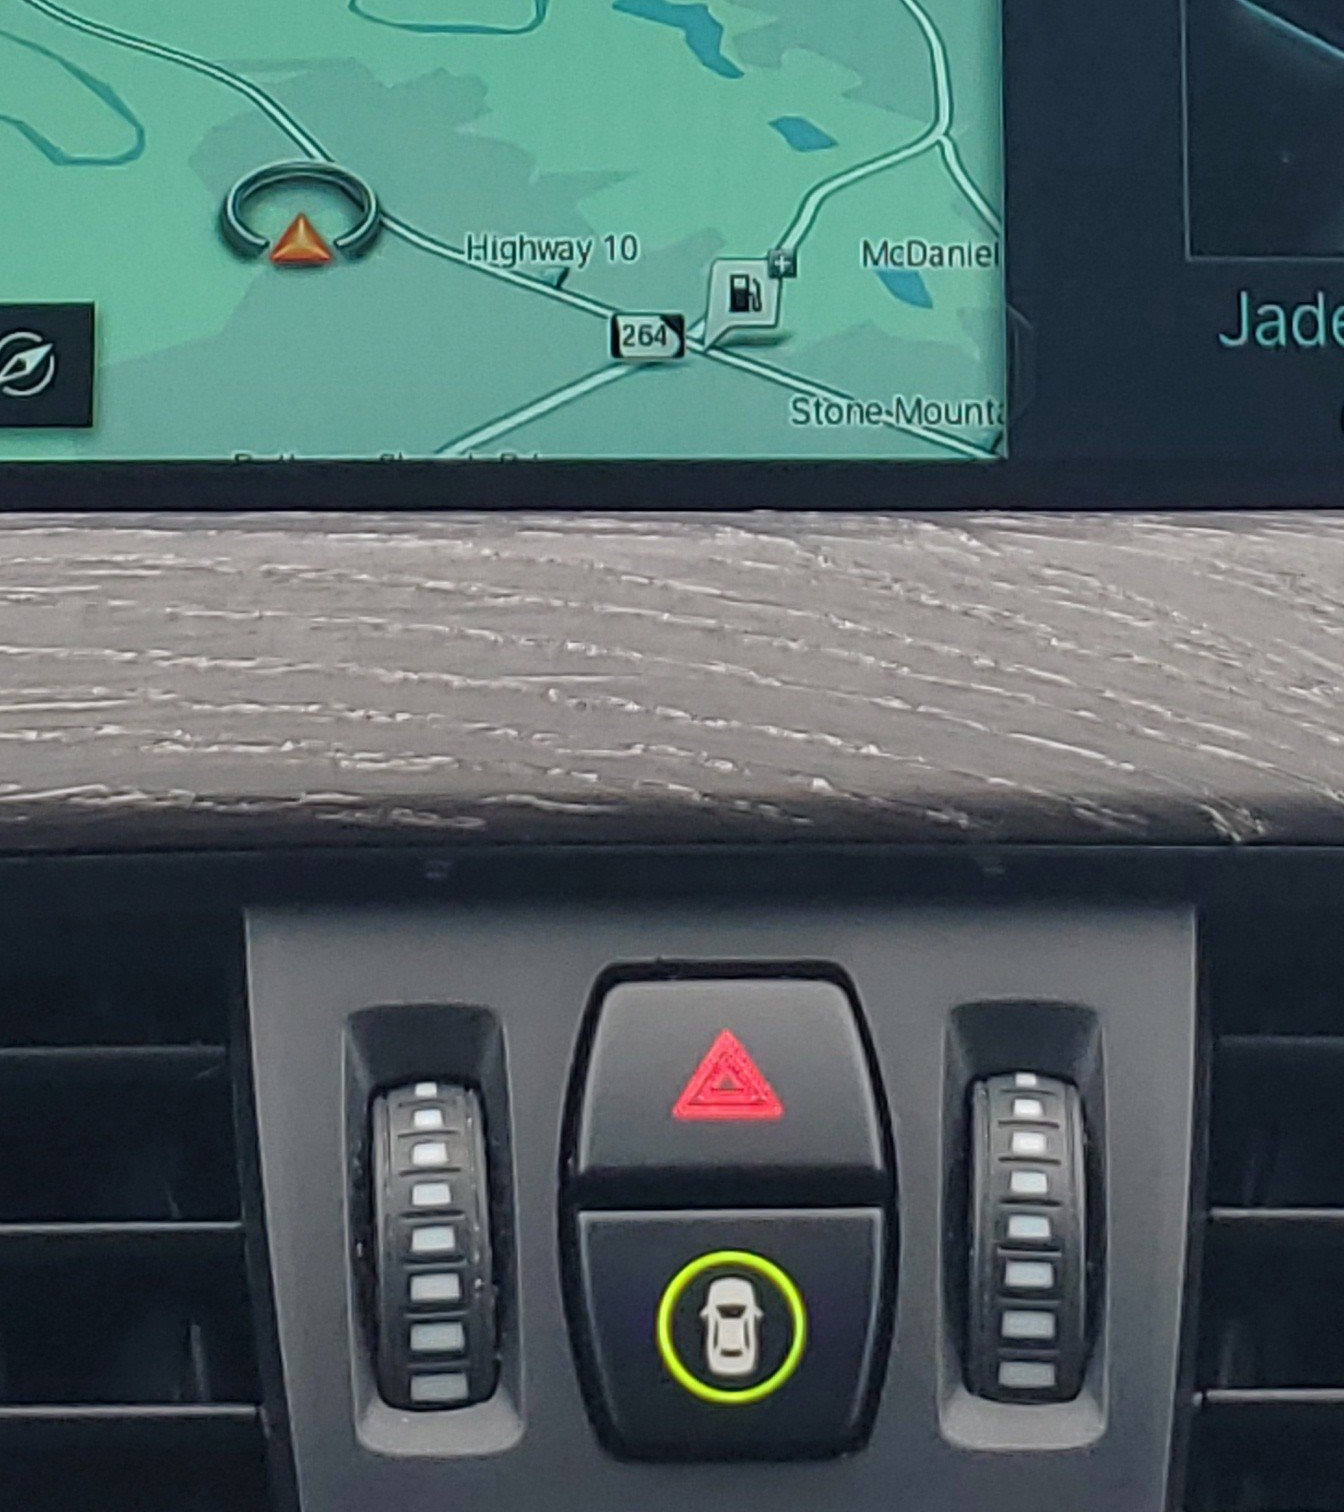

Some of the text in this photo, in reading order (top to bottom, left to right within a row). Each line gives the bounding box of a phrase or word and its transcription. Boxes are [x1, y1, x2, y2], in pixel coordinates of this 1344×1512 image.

[466, 234, 638, 266] Highway 10
[861, 238, 1001, 269] McDaniel
[622, 323, 668, 349] 264
[790, 395, 884, 427] Stone
